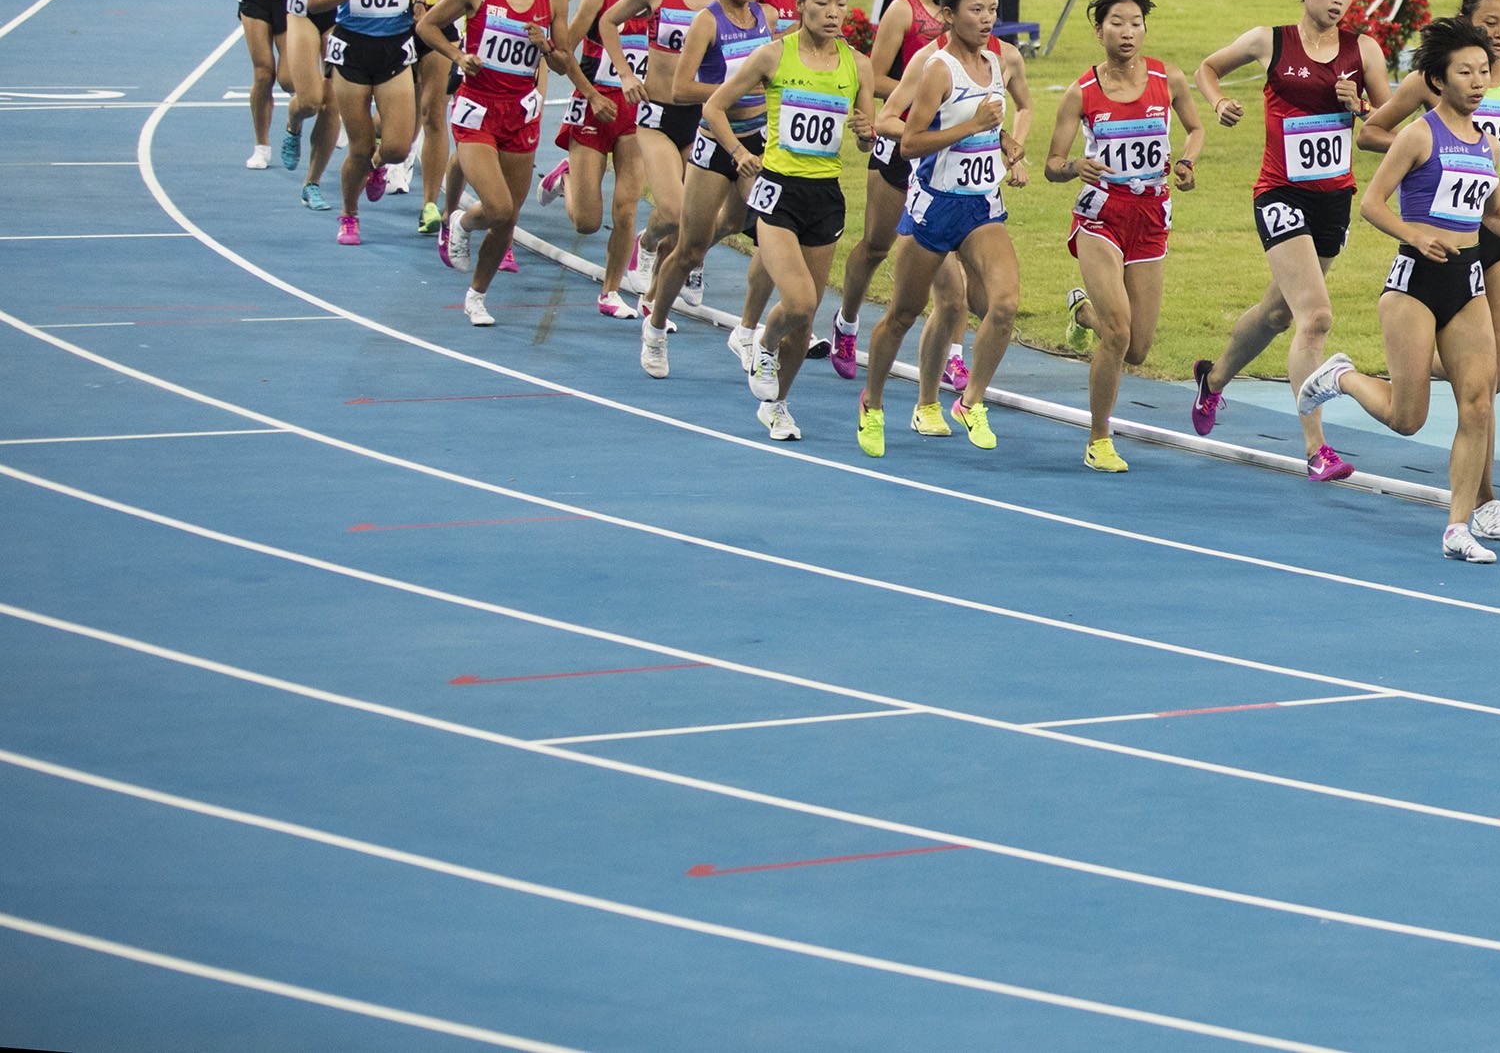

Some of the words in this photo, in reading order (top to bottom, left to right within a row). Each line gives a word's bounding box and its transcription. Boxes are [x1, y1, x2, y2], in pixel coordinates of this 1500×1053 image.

[485, 35, 540, 68] 1080
[1283, 66, 1311, 79] 上海
[463, 101, 477, 124] 7
[638, 104, 653, 128] 2
[790, 112, 836, 146] 608
[1099, 140, 1162, 172] 1136
[1298, 135, 1343, 170] 980
[956, 155, 996, 187] 309
[752, 179, 776, 210] 13
[1078, 189, 1098, 214] 4
[1267, 205, 1300, 234] 23
